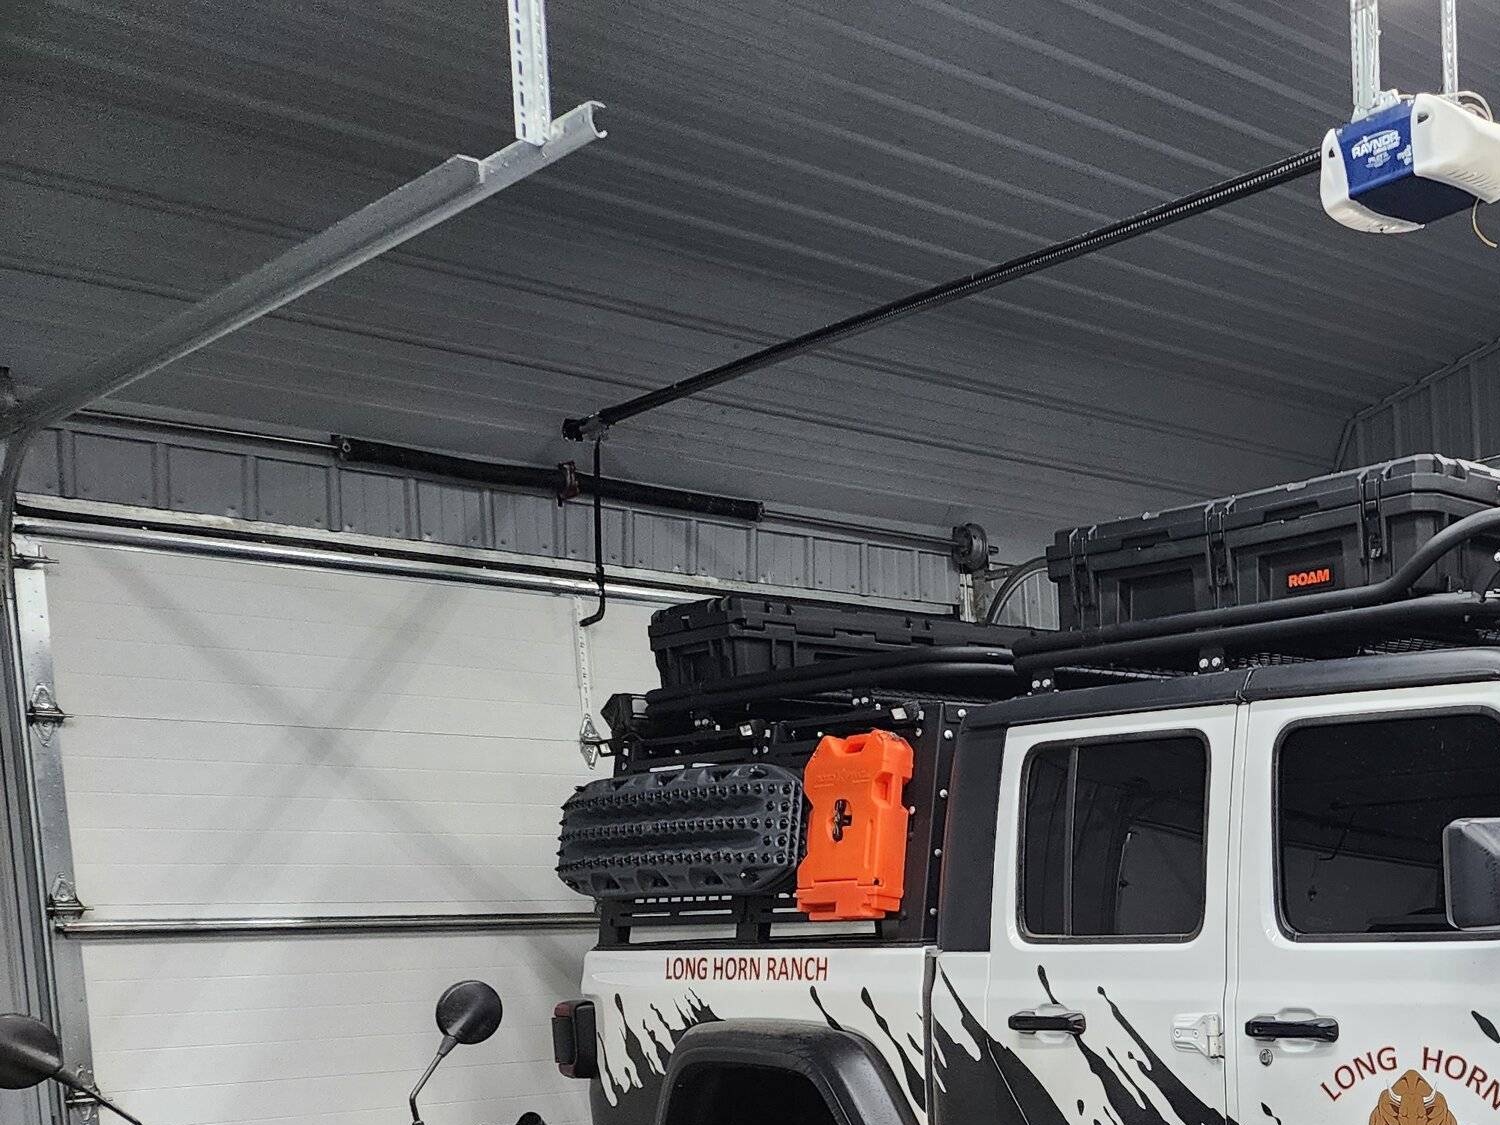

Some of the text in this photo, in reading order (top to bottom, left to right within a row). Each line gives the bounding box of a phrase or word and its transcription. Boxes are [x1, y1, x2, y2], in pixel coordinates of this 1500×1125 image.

[1288, 568, 1330, 588] ROAM
[665, 957, 828, 982] LONG HORN RANCH
[1320, 1046, 1398, 1102] LONG
